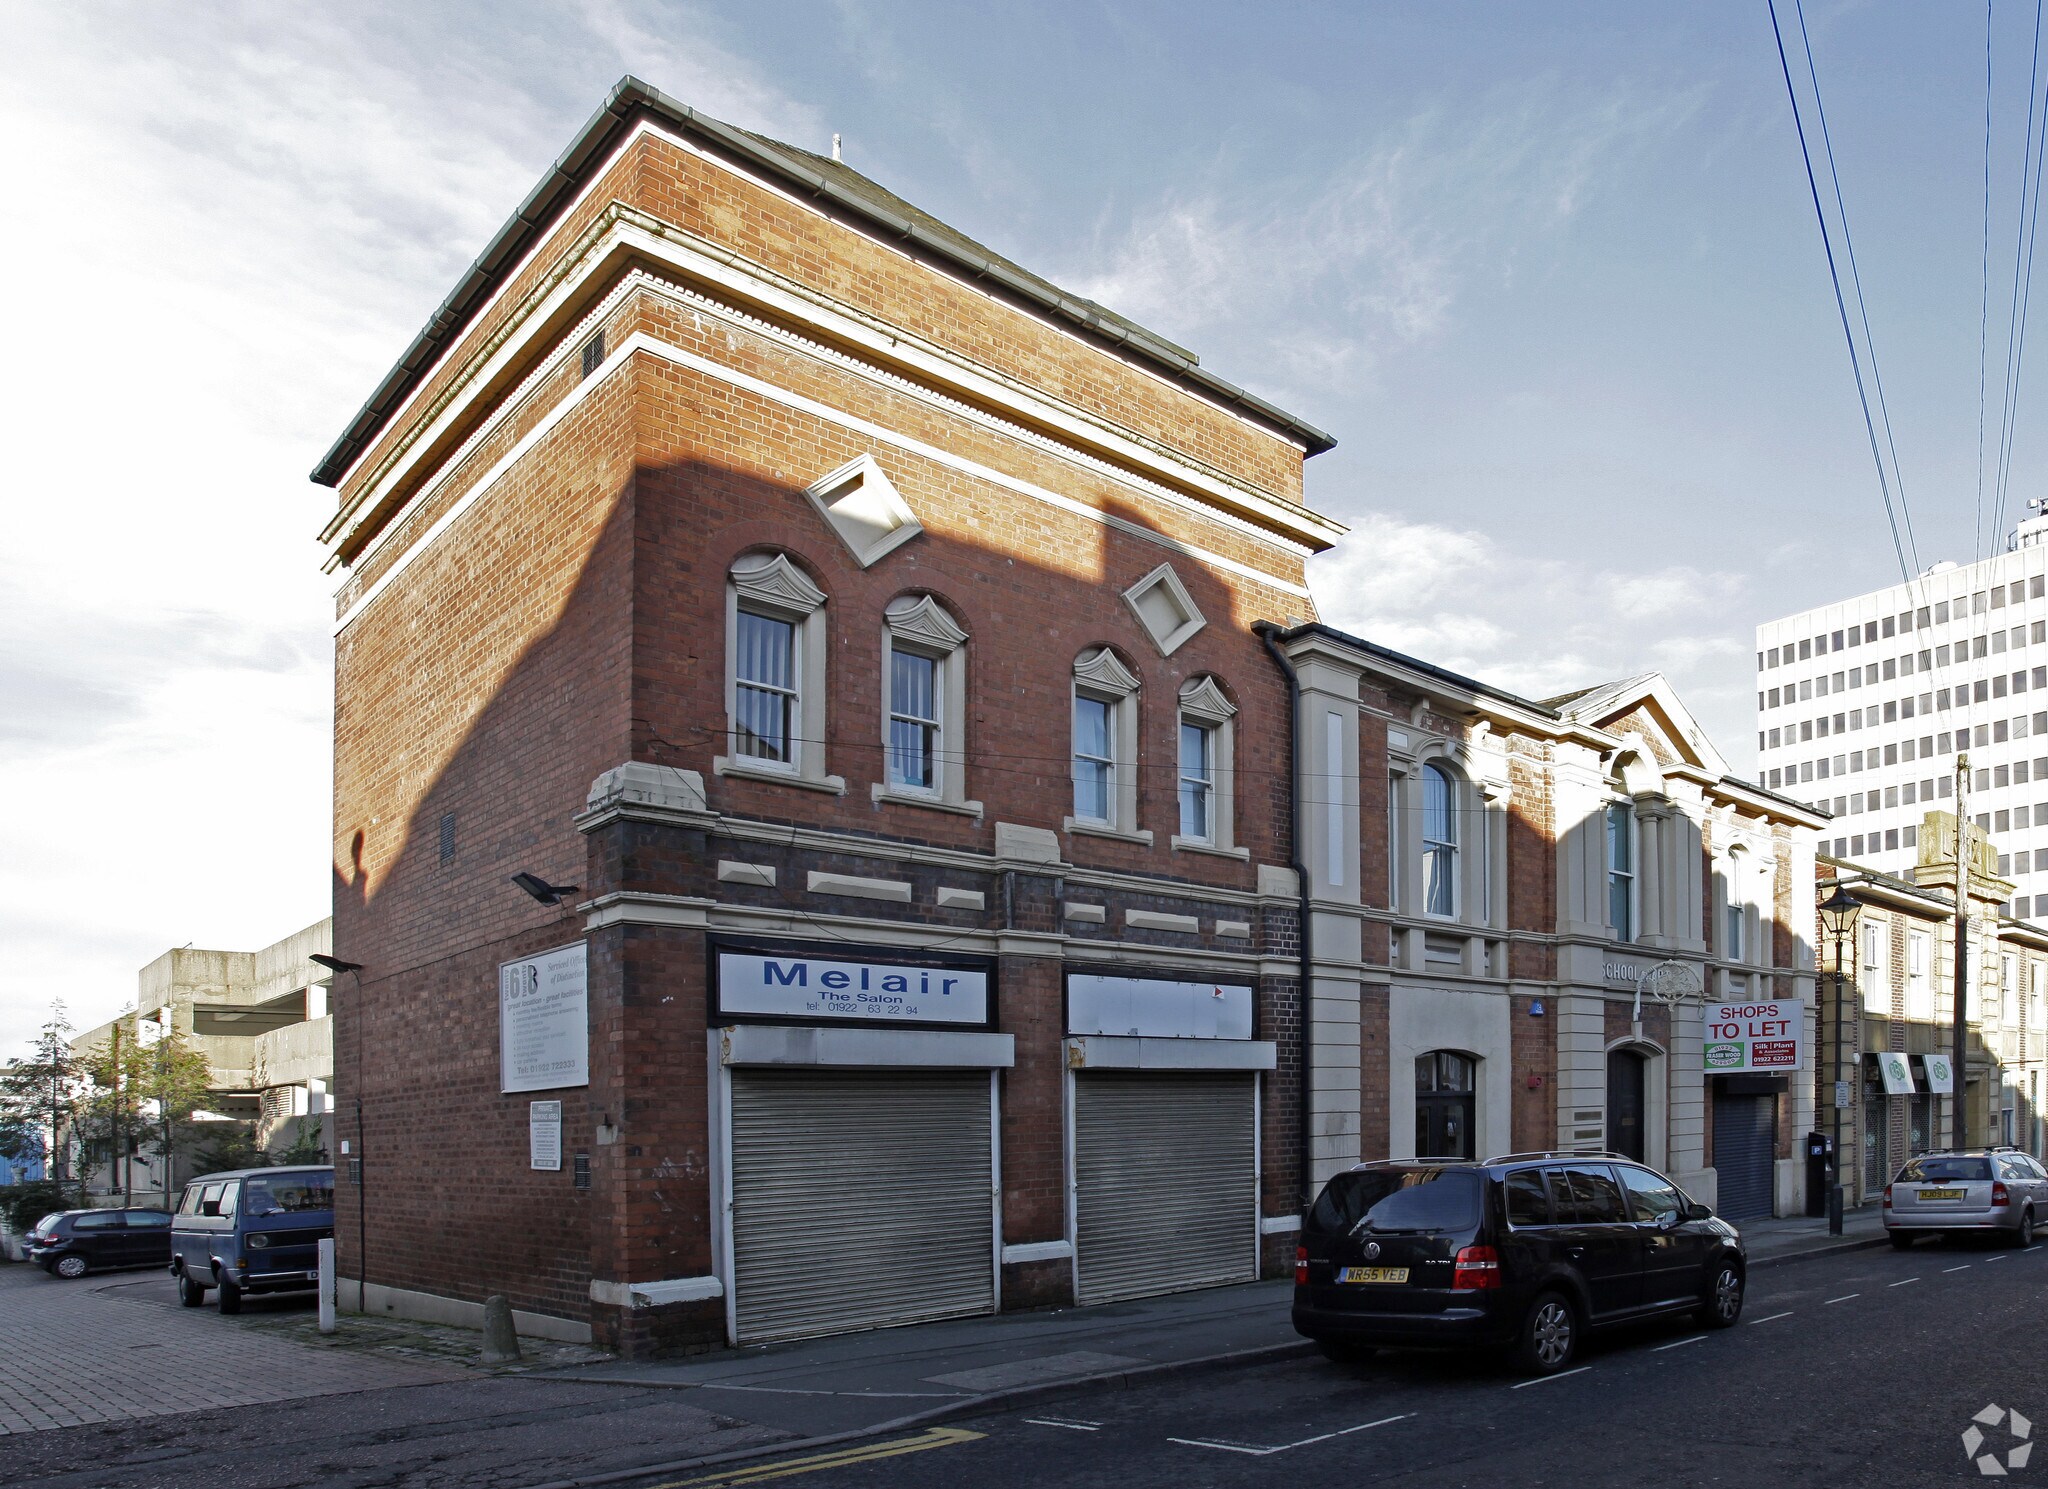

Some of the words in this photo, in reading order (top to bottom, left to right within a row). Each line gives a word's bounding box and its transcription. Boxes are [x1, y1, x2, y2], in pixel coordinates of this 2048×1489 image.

[509, 967, 520, 999] 6
[763, 961, 958, 996] Melair
[521, 997, 542, 1007] location
[545, 992, 561, 1004] great
[560, 988, 584, 999] facilities
[817, 991, 851, 1002] The
[856, 993, 902, 1004] Salon
[806, 1001, 820, 1011] tel:
[827, 1001, 858, 1013] 01922
[867, 1004, 881, 1014] 63
[887, 1004, 900, 1015] 22
[905, 1005, 918, 1015] 94
[1720, 1004, 1779, 1020] SHOPS
[1708, 1022, 1740, 1040] TO
[1748, 1019, 1791, 1038] LET
[517, 1066, 529, 1075] Tel:
[530, 1063, 550, 1073] 01922
[551, 1060, 576, 1071] 722333
[548, 1112, 559, 1120] AREA
[1347, 1269, 1379, 1281] WR55
[1382, 1269, 1407, 1281] VEB
